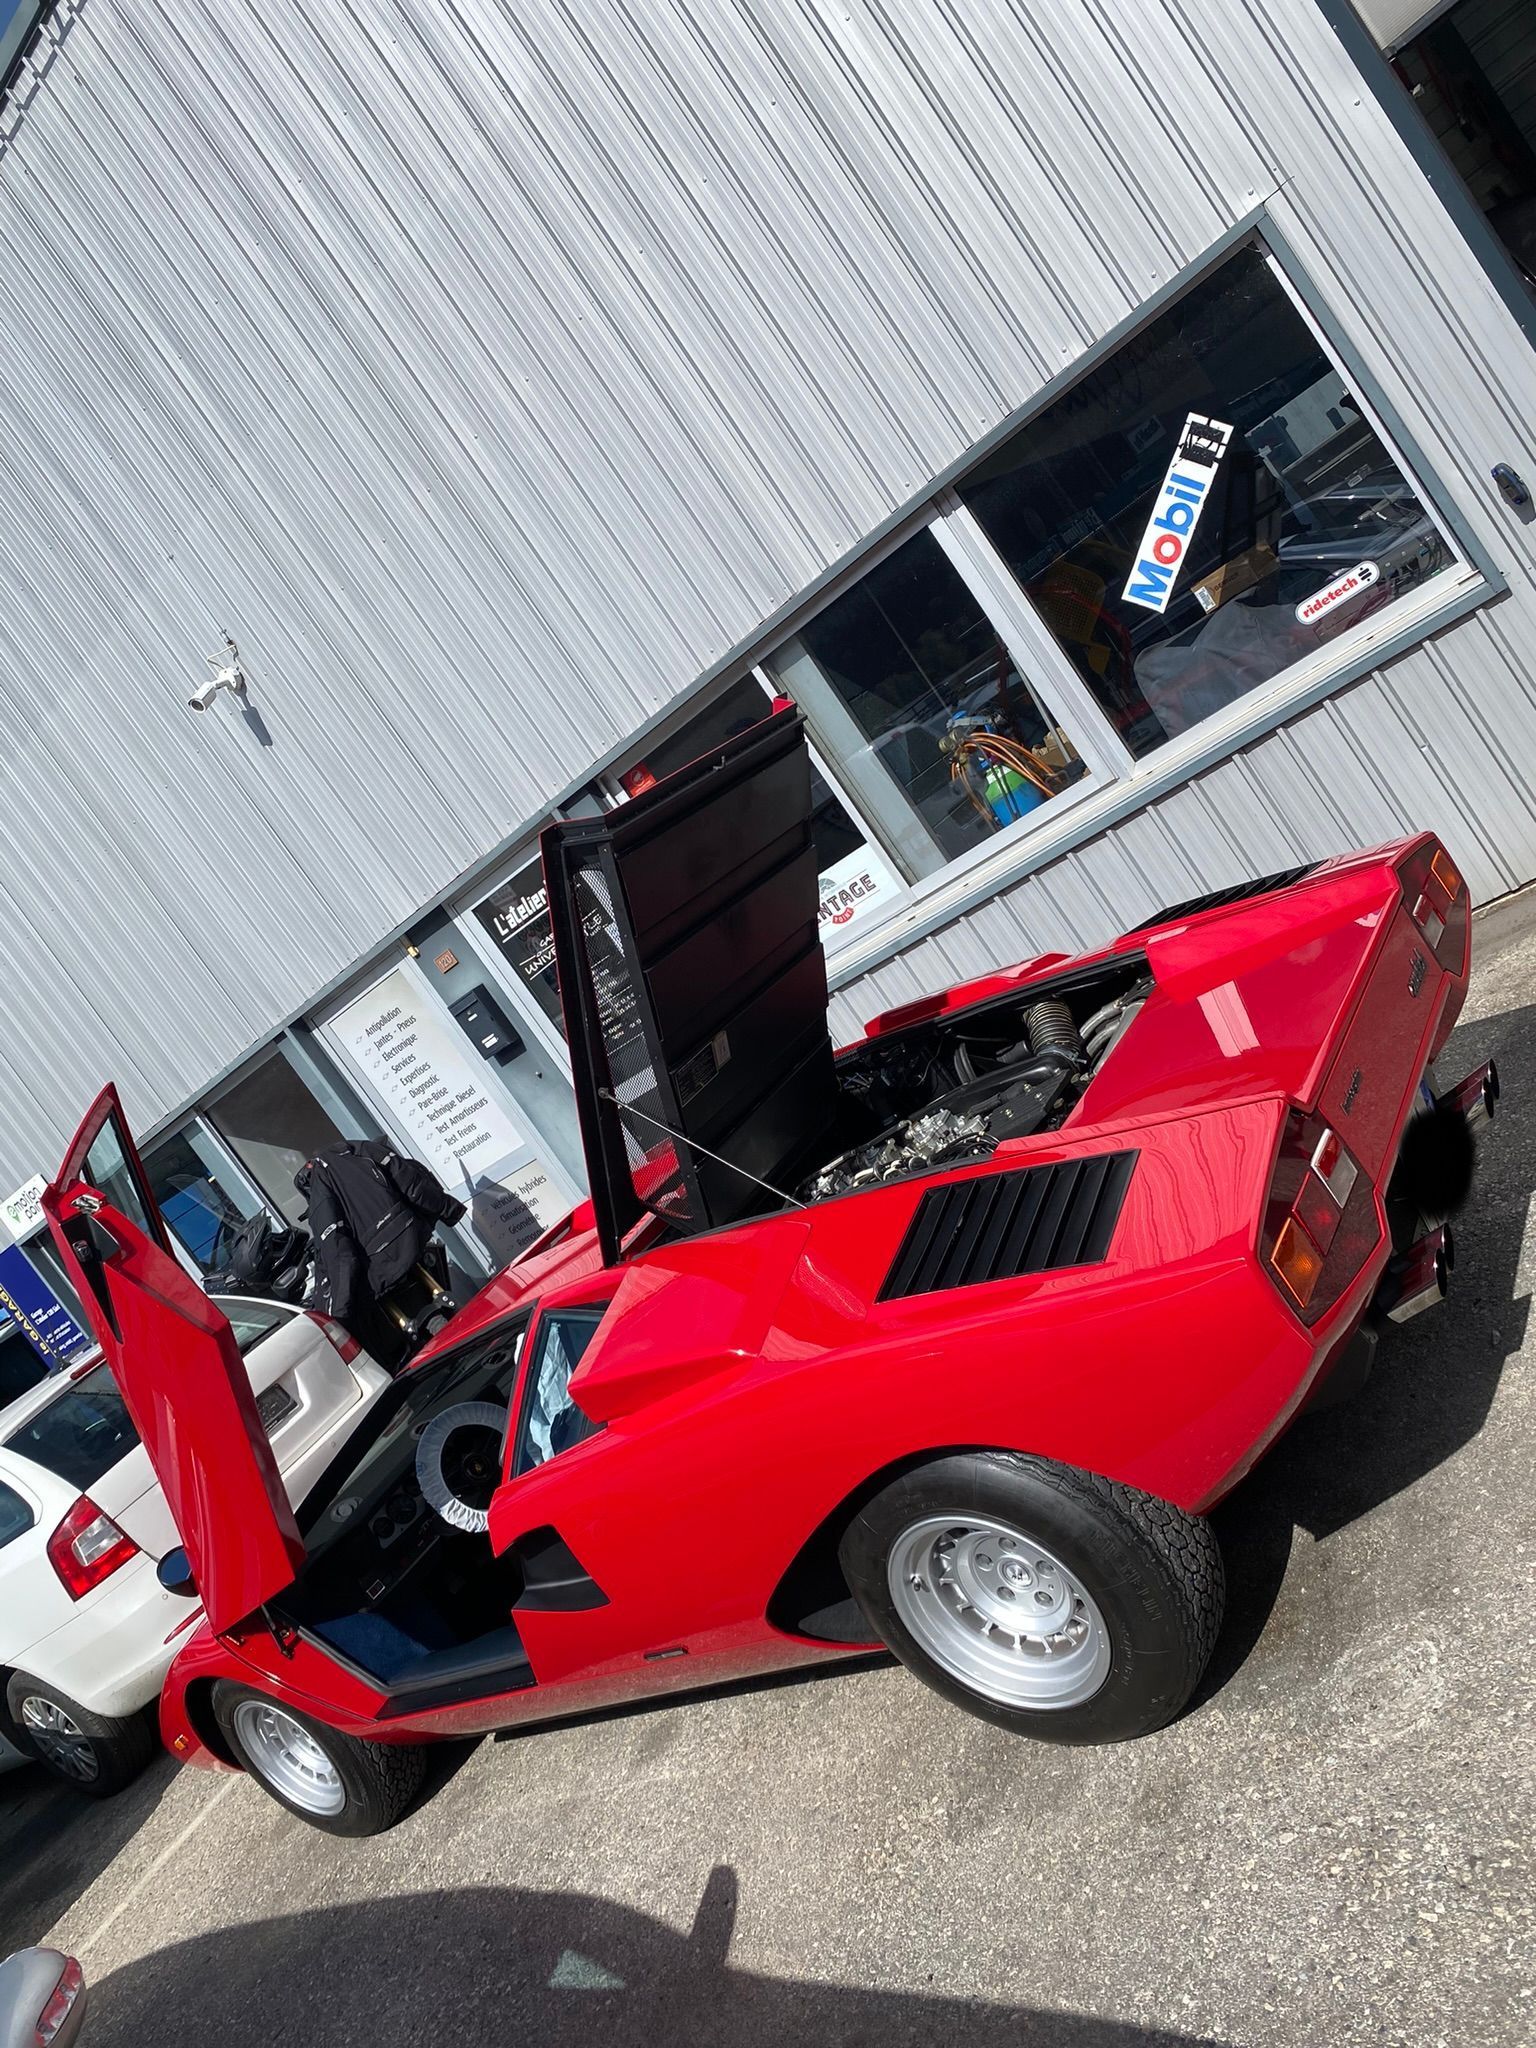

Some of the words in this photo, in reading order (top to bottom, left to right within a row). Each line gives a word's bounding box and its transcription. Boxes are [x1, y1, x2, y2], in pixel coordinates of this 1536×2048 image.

[1128, 473, 1206, 606] Mobil
[1302, 576, 1358, 618] ridetech
[493, 887, 547, 936] L'atelier
[818, 874, 876, 923] NTAGE
[365, 1007, 402, 1037] Antipollution
[373, 1033, 394, 1051] Jantes
[396, 1015, 417, 1032] Pneus
[381, 1033, 418, 1062] Electronique
[391, 1053, 416, 1074] Services
[399, 1062, 431, 1086] Expertises
[408, 1074, 440, 1098] Diagnostic
[417, 1086, 449, 1110] Pare-Brise
[426, 1099, 457, 1122] Technique
[455, 1084, 476, 1103] Diesel
[435, 1121, 450, 1134] Test
[448, 1096, 488, 1126] Amortisseurs
[444, 1133, 459, 1146] Test
[457, 1122, 477, 1138] Freins
[452, 1131, 492, 1158] Restauration
[517, 1174, 547, 1194] hybrides
[25, 1199, 42, 1222] poin
